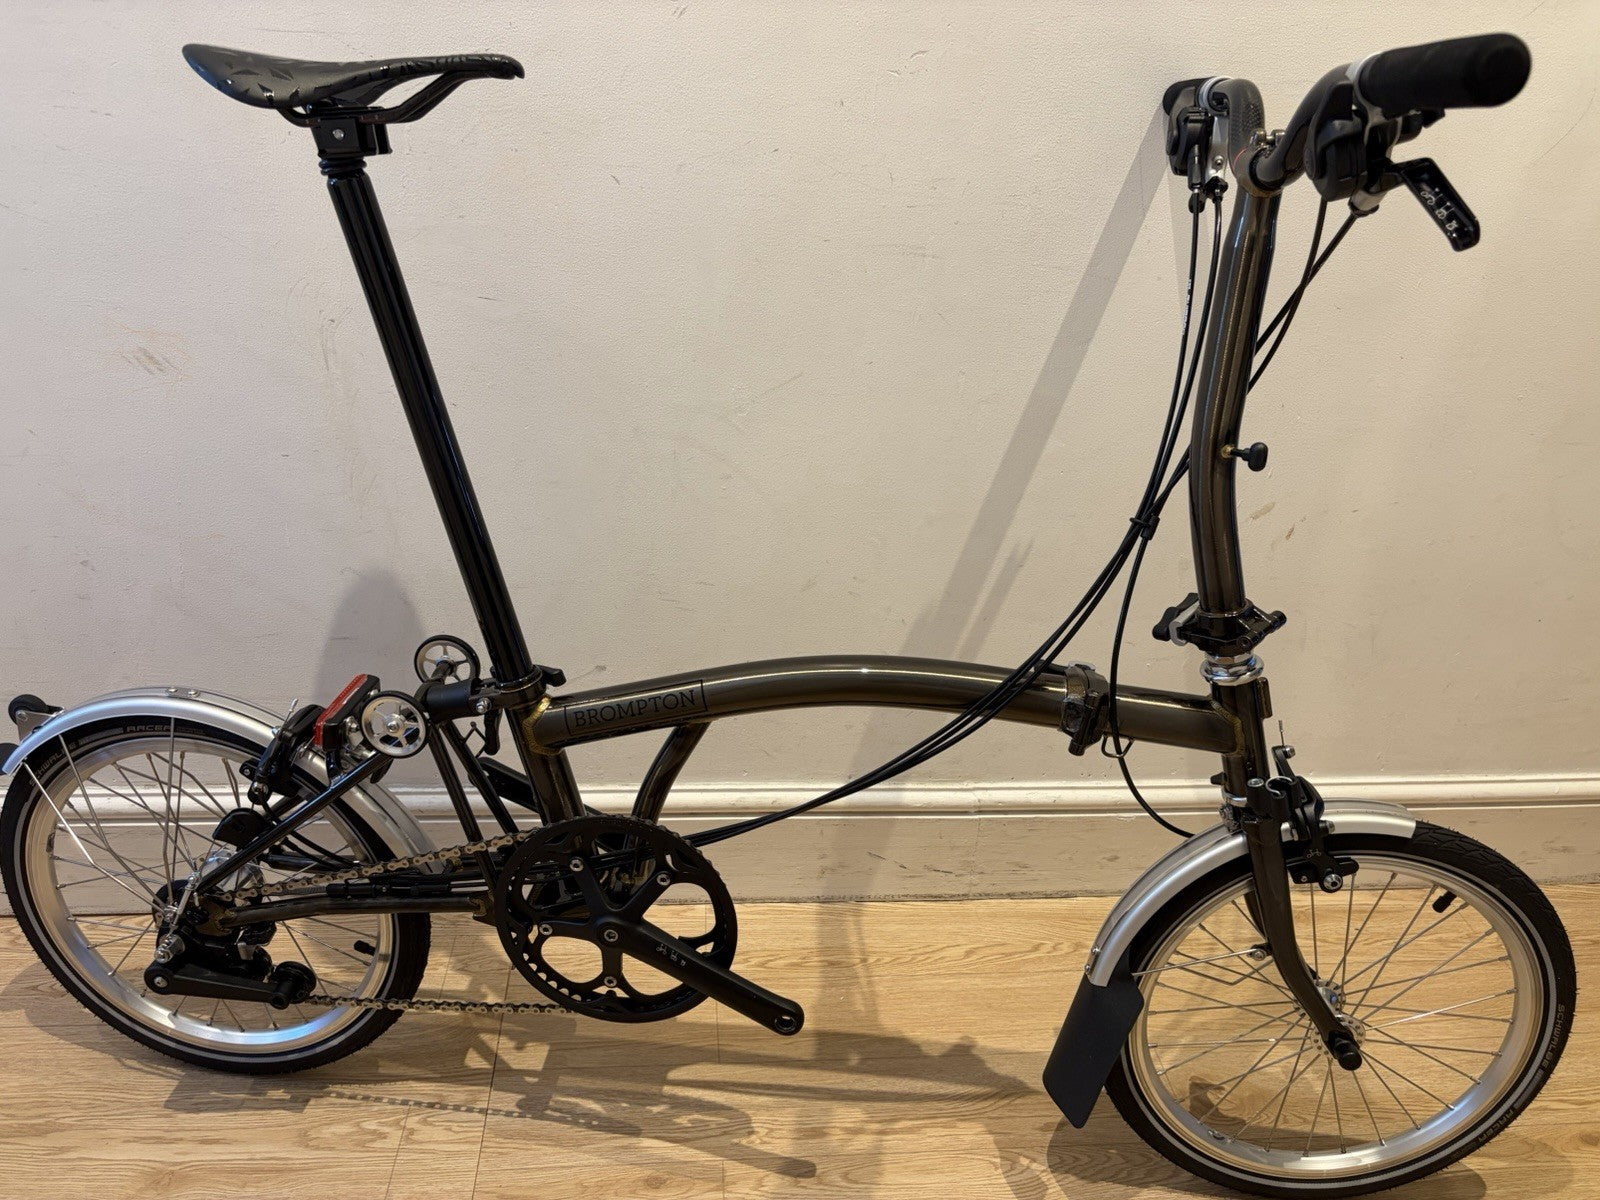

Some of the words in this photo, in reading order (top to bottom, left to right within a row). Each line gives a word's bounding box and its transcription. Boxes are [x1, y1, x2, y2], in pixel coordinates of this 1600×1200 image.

[574, 689, 696, 728] BROMPTON
[29, 742, 77, 787] SHWALE
[1542, 1003, 1566, 1069] SCHWALBE
